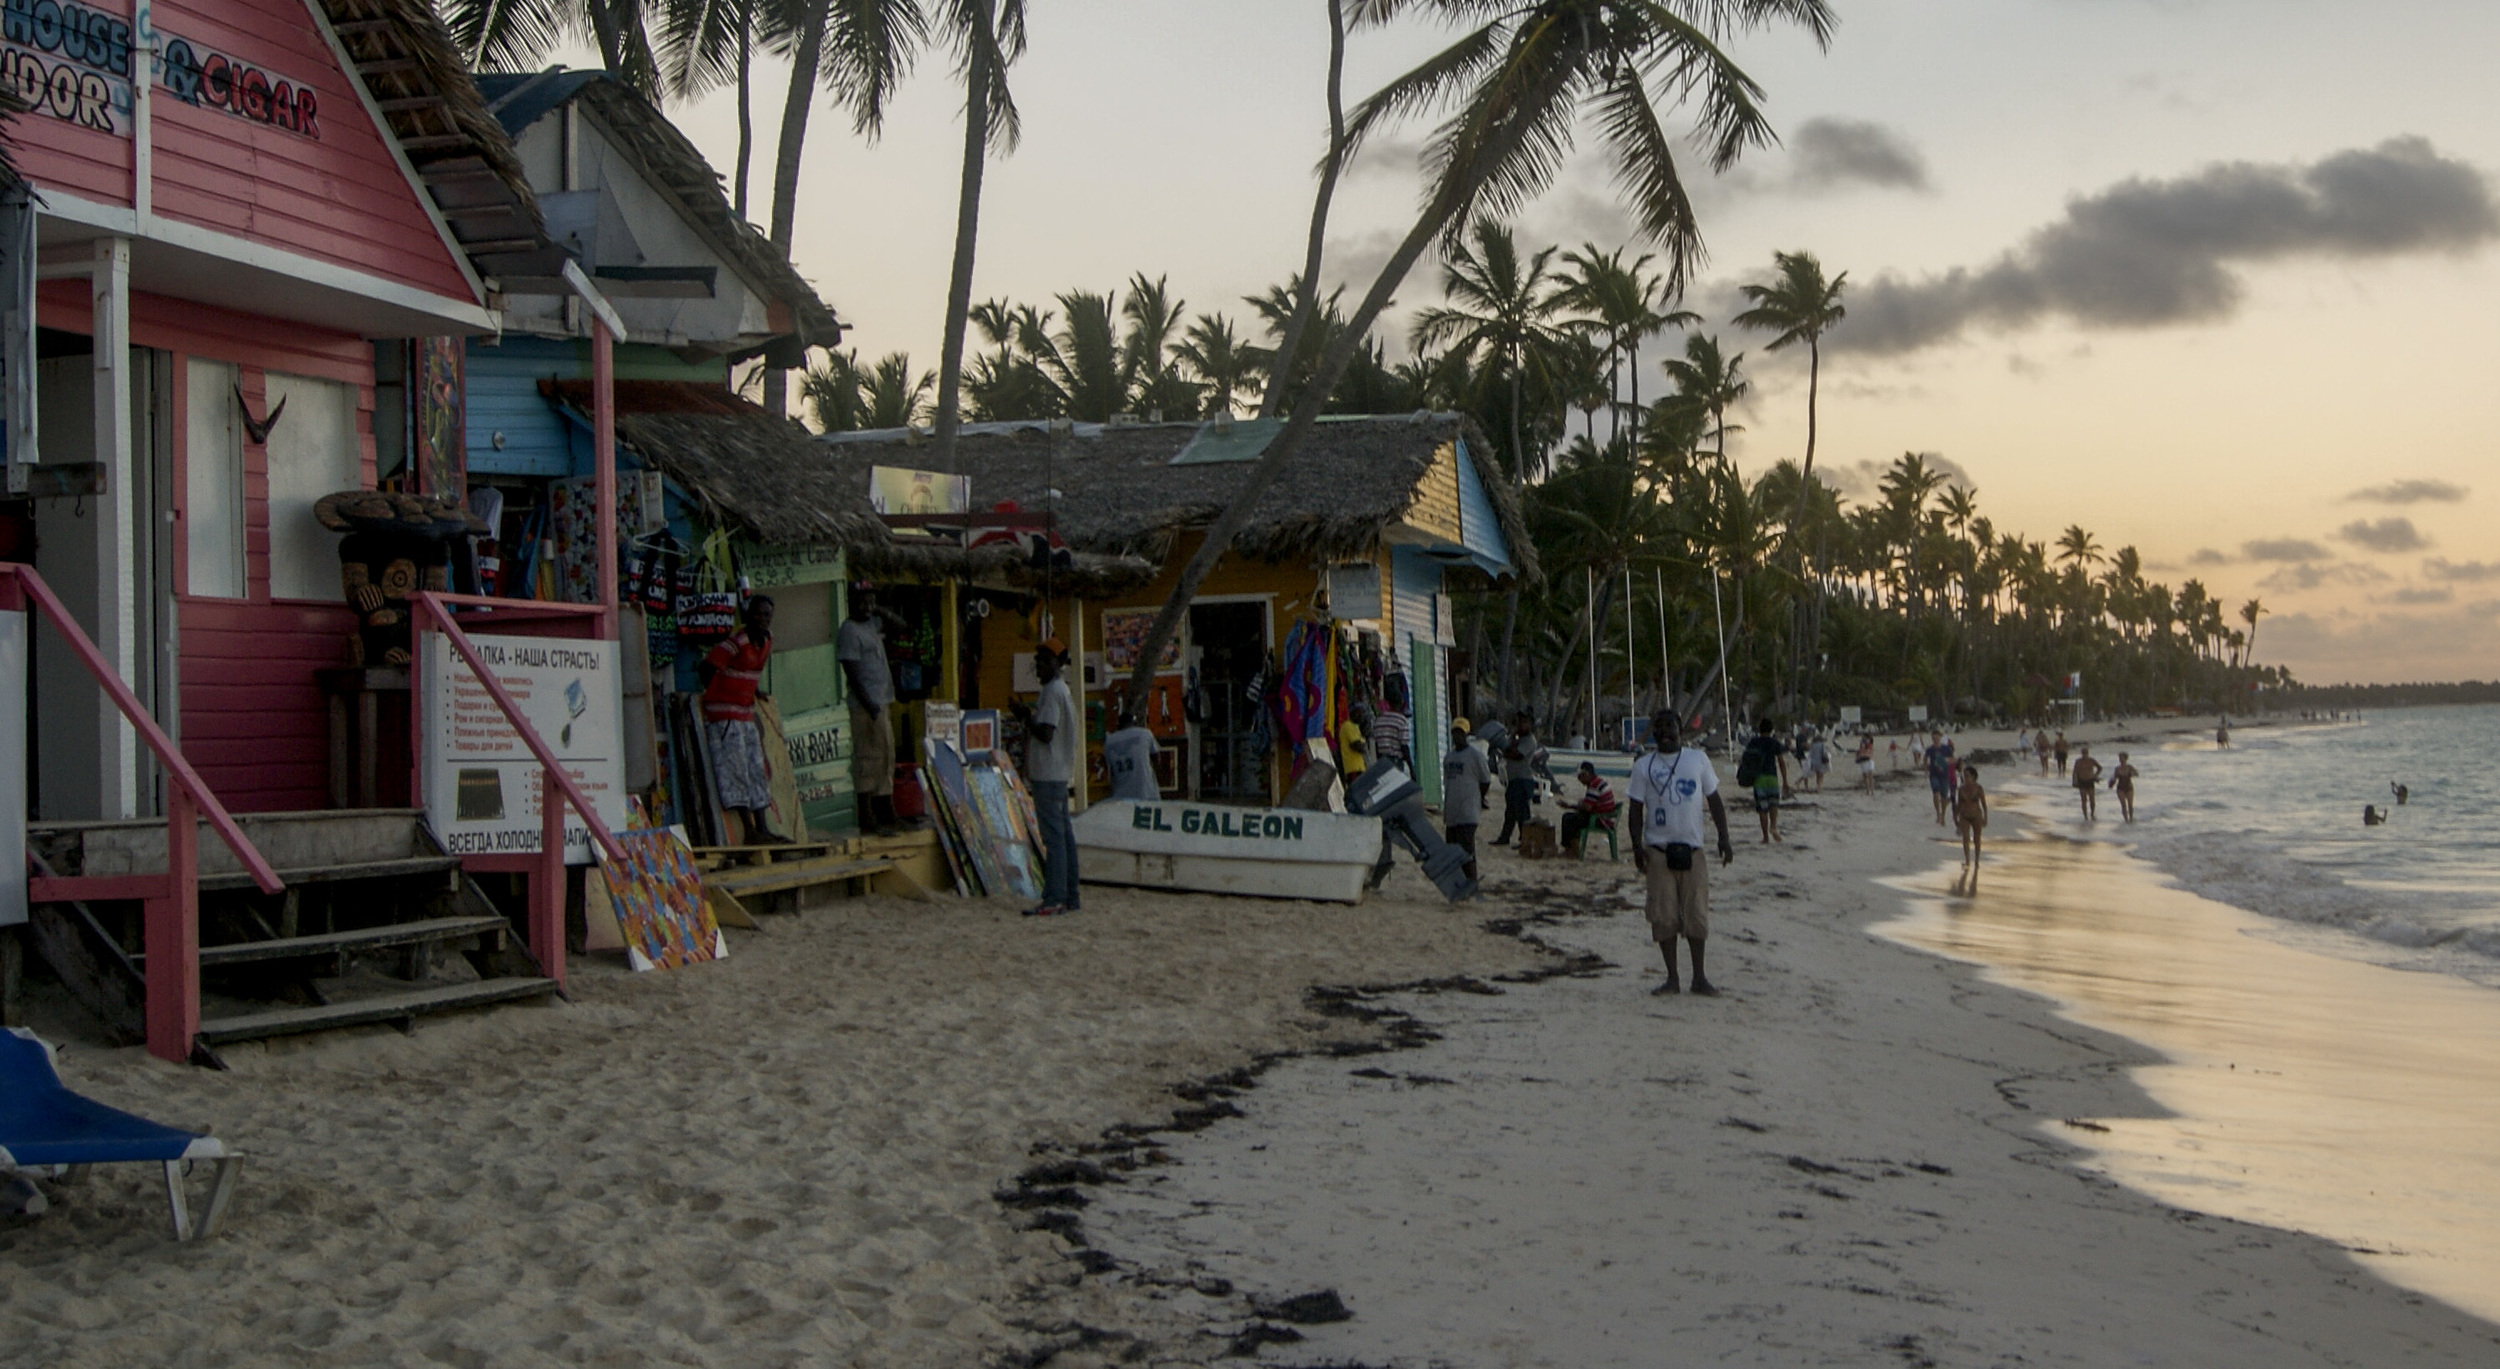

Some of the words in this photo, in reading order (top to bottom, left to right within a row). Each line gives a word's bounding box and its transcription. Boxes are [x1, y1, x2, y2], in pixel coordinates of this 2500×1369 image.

[4, 0, 129, 76] HOUSE
[201, 52, 320, 140] CIGAR
[0, 47, 114, 134] IDOR
[450, 643, 505, 665] РЫАЛКА
[515, 648, 548, 667] НАША
[551, 650, 600, 670] СТРАСТЬ!
[808, 728, 839, 763] BOAT
[1132, 805, 1172, 832] EL
[1181, 809, 1303, 840] GALEON
[449, 831, 493, 853] ВСЕГДА
[496, 830, 543, 853] ХОЛОДН
